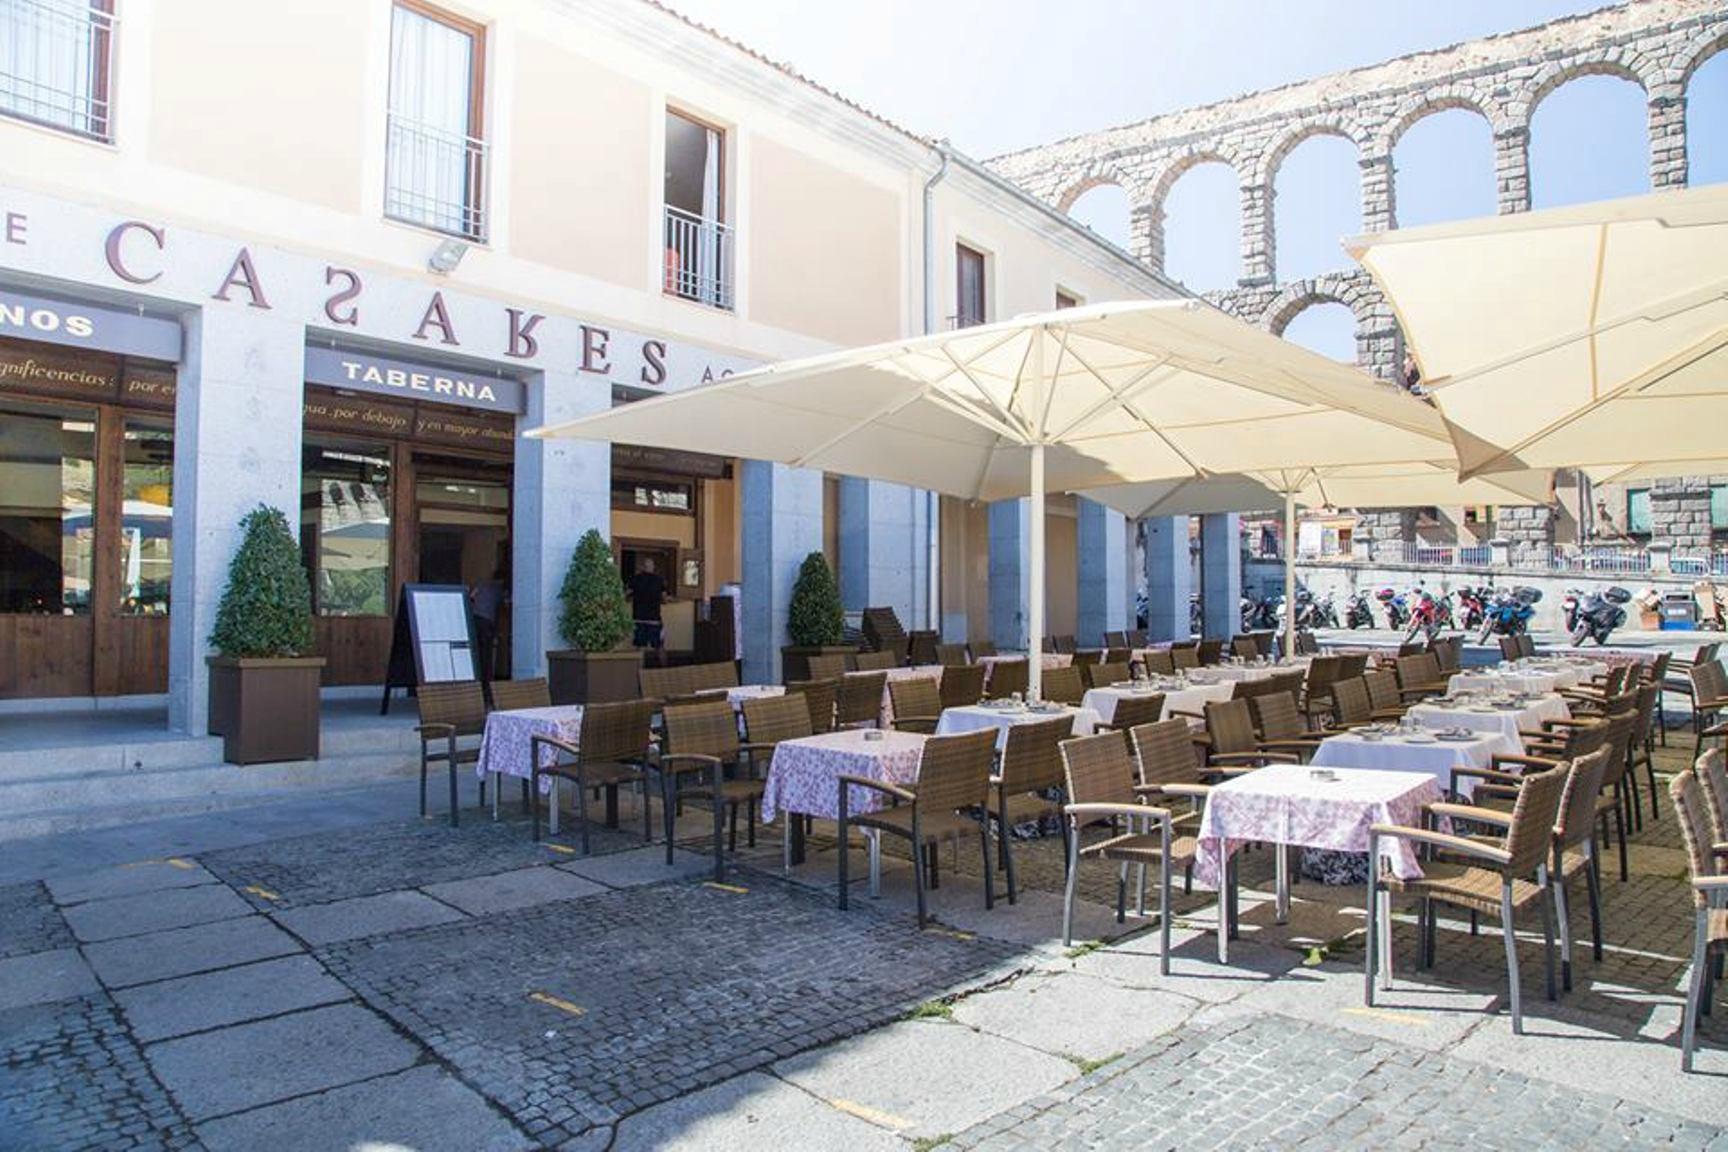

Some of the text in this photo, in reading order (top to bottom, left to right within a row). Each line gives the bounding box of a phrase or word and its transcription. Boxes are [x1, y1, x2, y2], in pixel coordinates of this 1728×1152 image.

[6, 212, 27, 245] E
[105, 221, 667, 385] CASARES
[0, 303, 94, 337] NOS
[128, 380, 157, 393] por
[342, 362, 496, 401] TABERNA
[334, 409, 359, 419] por
[362, 408, 407, 429] debajo
[444, 424, 480, 438] mayor
